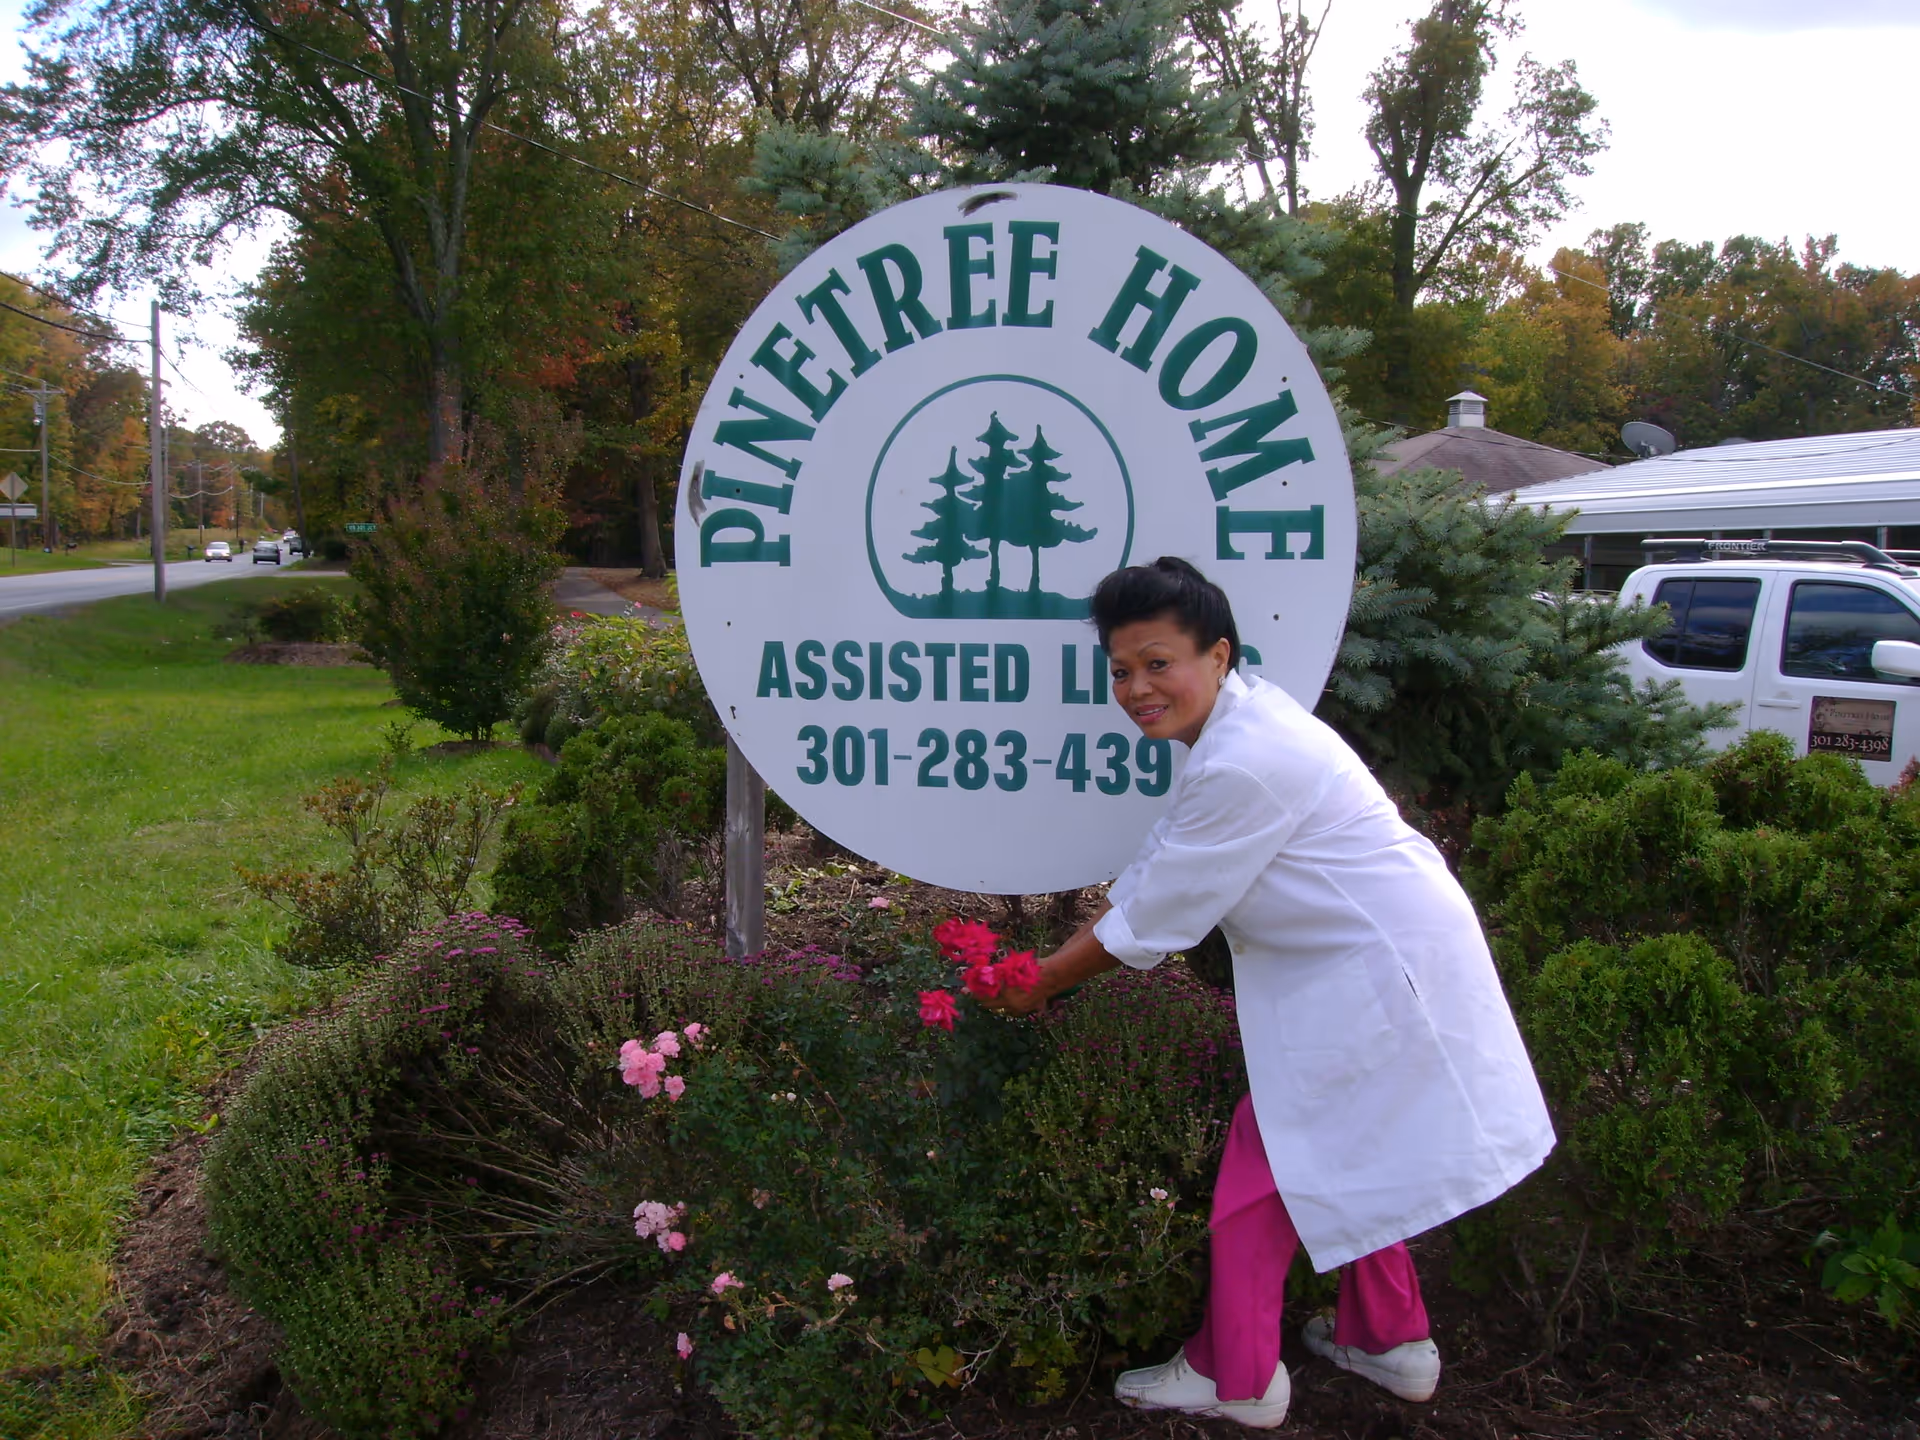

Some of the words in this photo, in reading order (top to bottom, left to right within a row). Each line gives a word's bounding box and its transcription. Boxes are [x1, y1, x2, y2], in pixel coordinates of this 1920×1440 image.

[700, 221, 1060, 568] PINETREE
[1087, 245, 1325, 561] HOME
[1707, 541, 1767, 551] FRONTIER
[756, 639, 1031, 704] ASSISTED
[796, 724, 1173, 798] 301-283-439
[1810, 734, 1832, 748] 301
[1834, 734, 1889, 753] 283-4398
